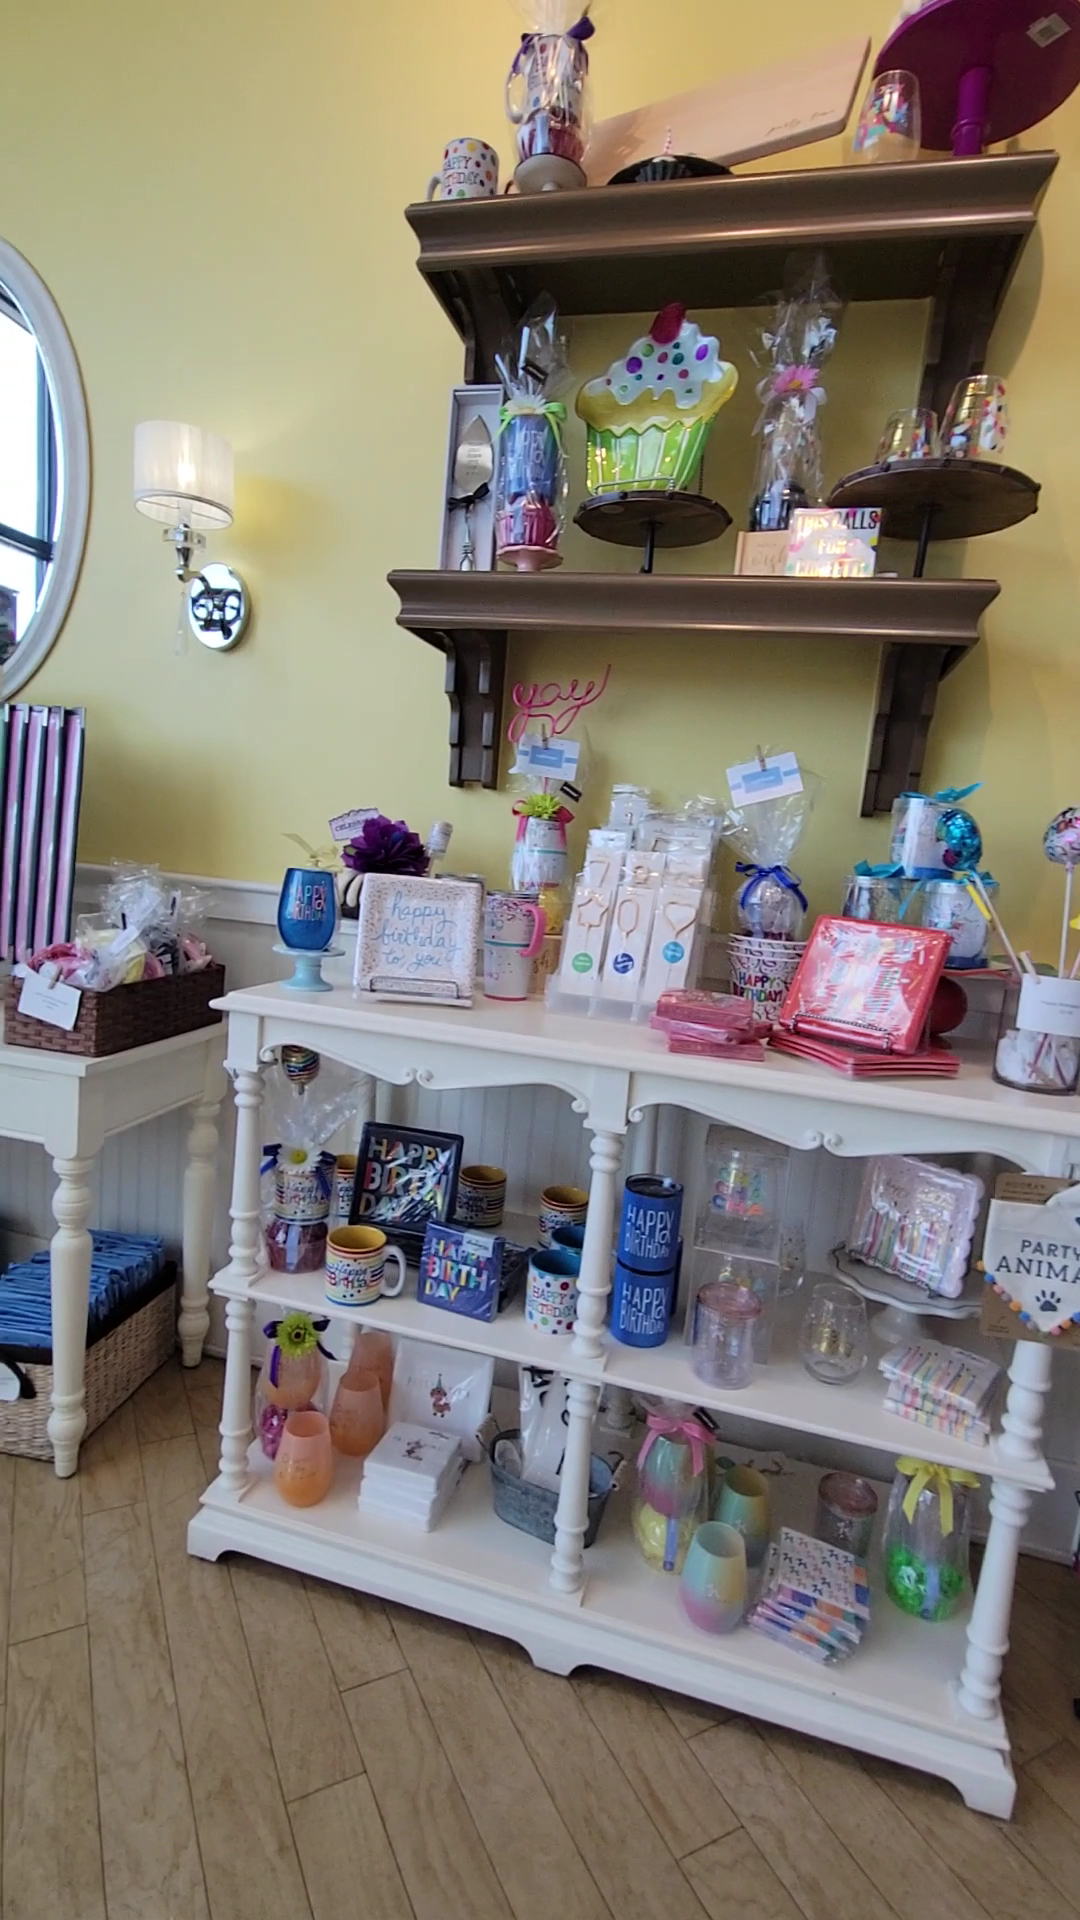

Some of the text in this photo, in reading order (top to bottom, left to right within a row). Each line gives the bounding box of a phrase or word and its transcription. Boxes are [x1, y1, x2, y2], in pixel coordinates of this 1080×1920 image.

[508, 664, 611, 743] yay
[385, 890, 458, 934] happy
[370, 918, 463, 962] birthday
[382, 947, 405, 965] to
[406, 952, 443, 974] you
[739, 971, 777, 988] HAPPY
[624, 1222, 671, 1259] BIRTHDAY
[625, 1204, 674, 1244] HAPPY
[1021, 1239, 1080, 1261] PARTY
[425, 1278, 462, 1303] DAY
[427, 1256, 489, 1292] BIRTH
[532, 1285, 567, 1305] HAPPY
[622, 1282, 670, 1320] HAPPY
[619, 1300, 666, 1334] BIRTHDAY
